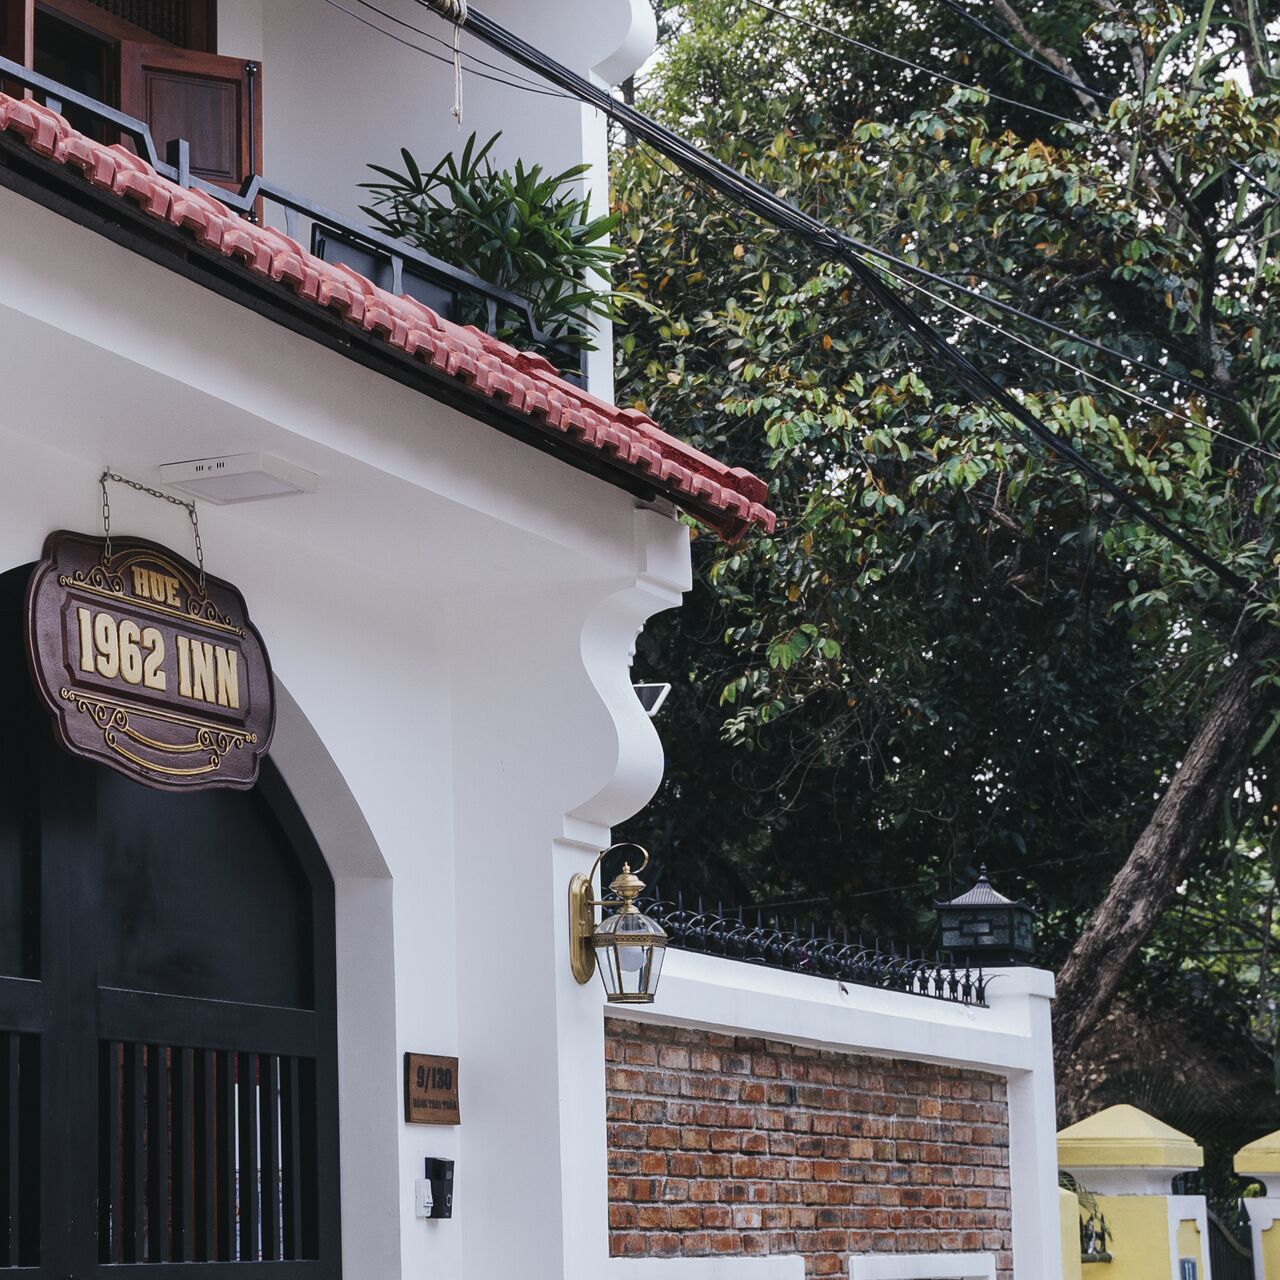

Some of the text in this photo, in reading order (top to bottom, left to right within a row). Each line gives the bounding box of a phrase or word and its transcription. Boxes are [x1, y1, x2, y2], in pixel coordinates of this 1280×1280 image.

[78, 607, 240, 709] 1962 INN
[416, 1064, 453, 1093] 9/130
